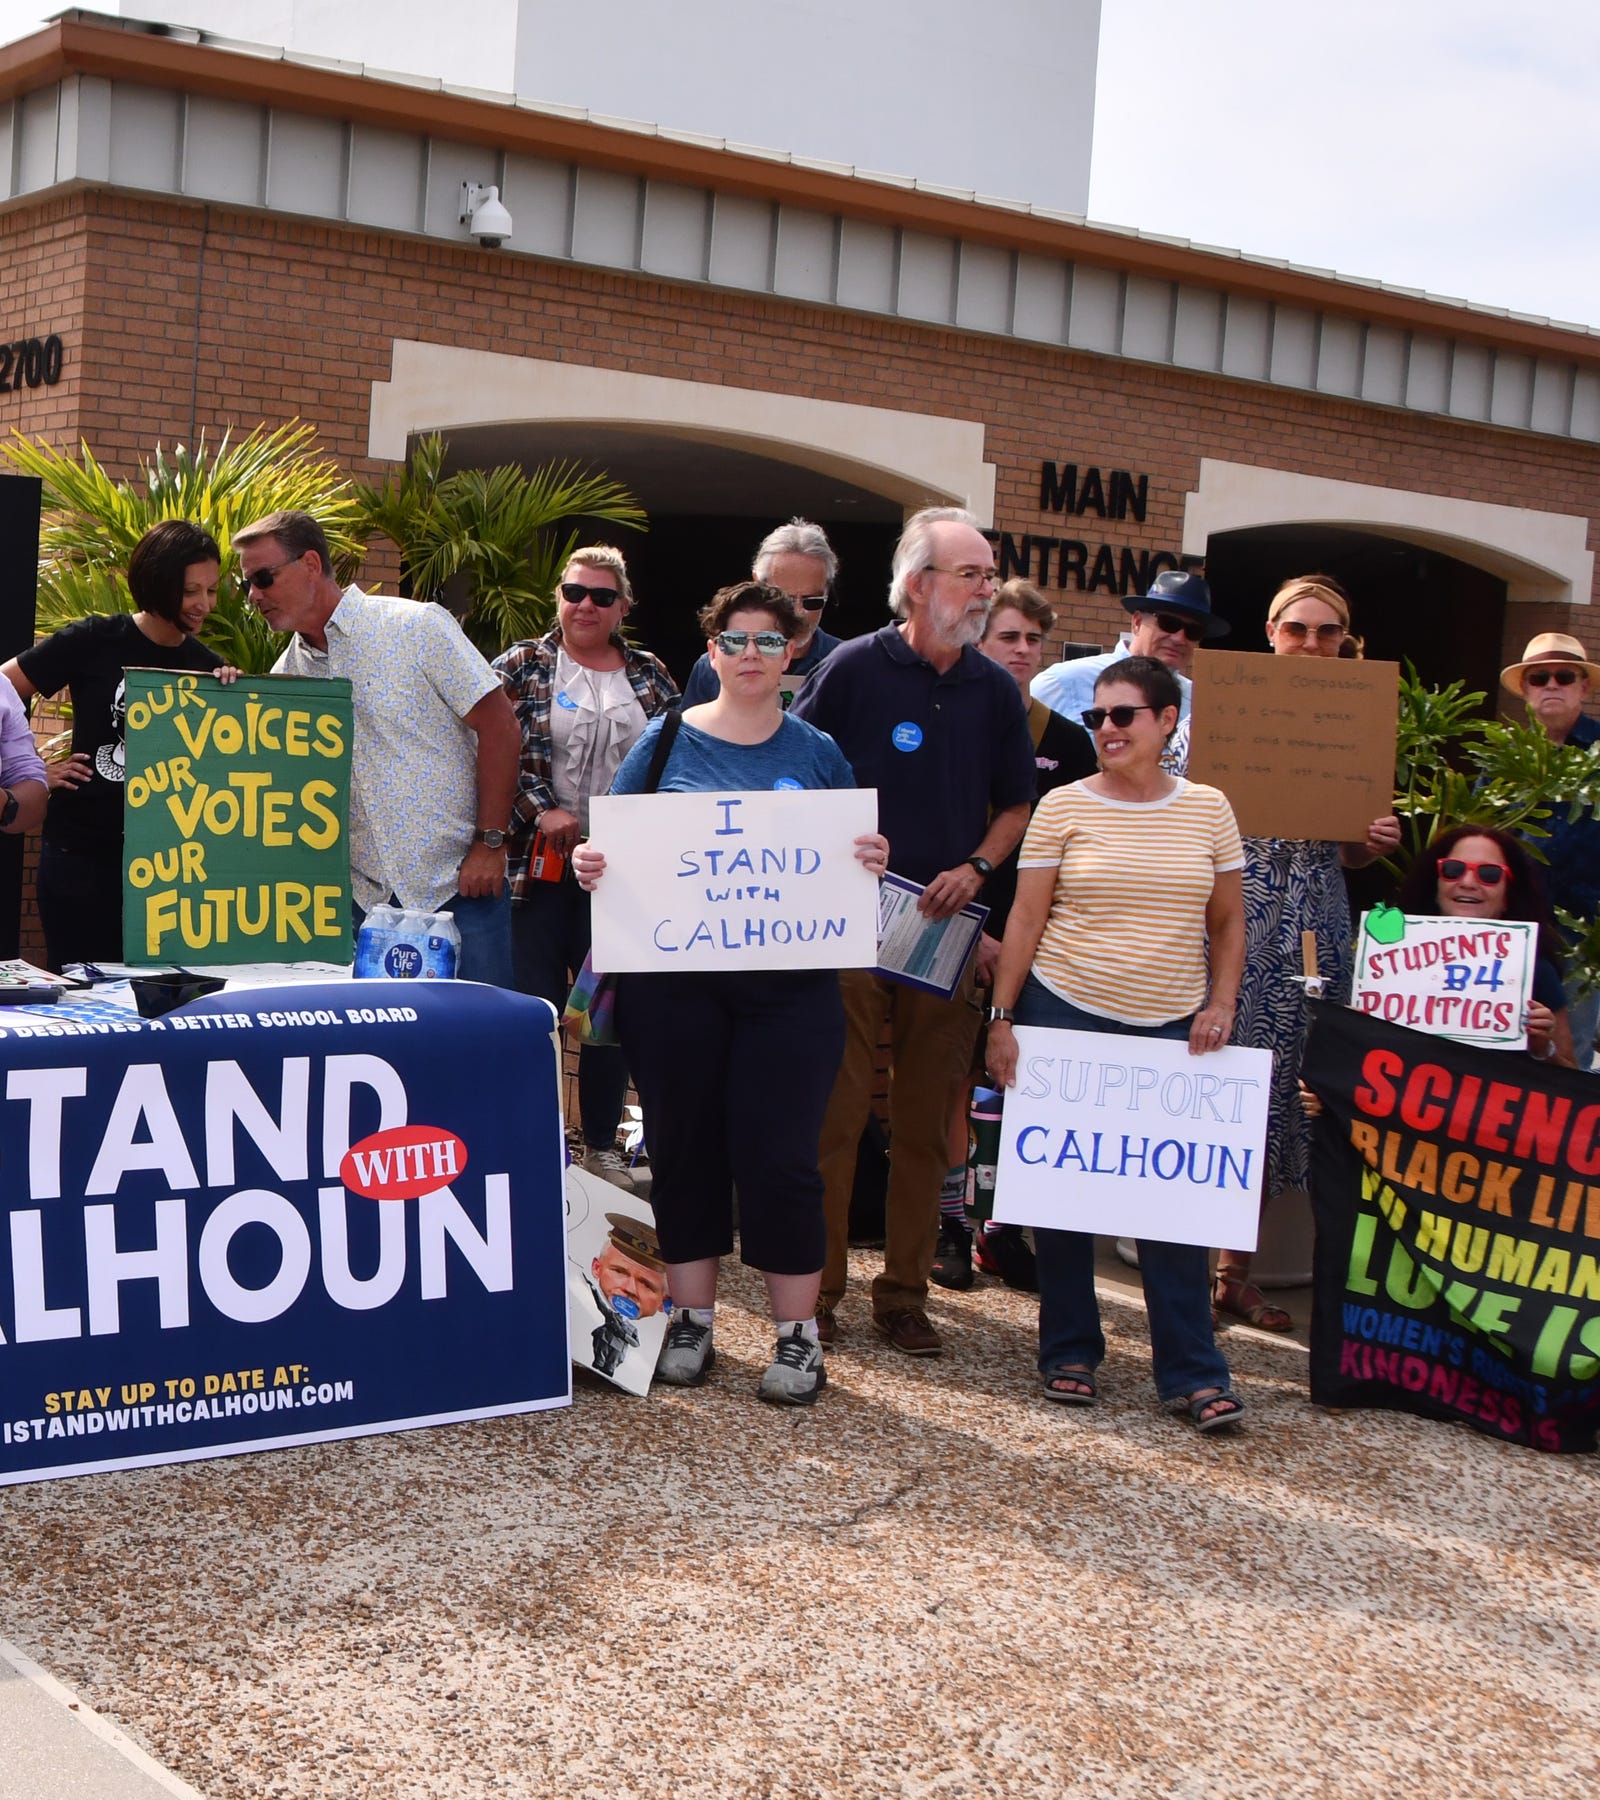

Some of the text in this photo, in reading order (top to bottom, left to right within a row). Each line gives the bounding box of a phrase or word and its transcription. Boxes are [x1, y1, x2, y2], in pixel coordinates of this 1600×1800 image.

[1040, 461, 1149, 521] MAIN
[127, 676, 207, 730] OUR
[127, 757, 197, 808] OUR
[166, 772, 341, 850] VOTES
[715, 800, 743, 835] I
[128, 841, 208, 889] OUR
[677, 846, 821, 877] STAND
[146, 881, 342, 956] FUTURE
[706, 886, 780, 902] WITH
[391, 947, 418, 960] Pure
[654, 917, 846, 952] CALHOUN
[1368, 931, 1512, 979] STUDENTS
[393, 959, 414, 971] Life
[1442, 959, 1505, 992] B4
[150, 1021, 167, 1031] A
[169, 1013, 254, 1031] BETTER
[256, 1010, 343, 1028] SCHOOL
[345, 1007, 418, 1024] BOARD
[1358, 991, 1514, 1032] POLITICS
[1021, 1056, 1260, 1123] SUPPORT
[352, 1138, 459, 1187] WITH
[1016, 1125, 1254, 1190] CALHOUN
[1351, 1118, 1522, 1217] BLACK
[1414, 1210, 1600, 1301] HUMAN
[1342, 1302, 1465, 1366] WOMEN'S
[45, 1364, 310, 1414] STAY UP TO DATE AT:
[1340, 1338, 1522, 1435] KINDNESS
[3, 1380, 354, 1444] ISTANDWITHCALHOUN.COM
